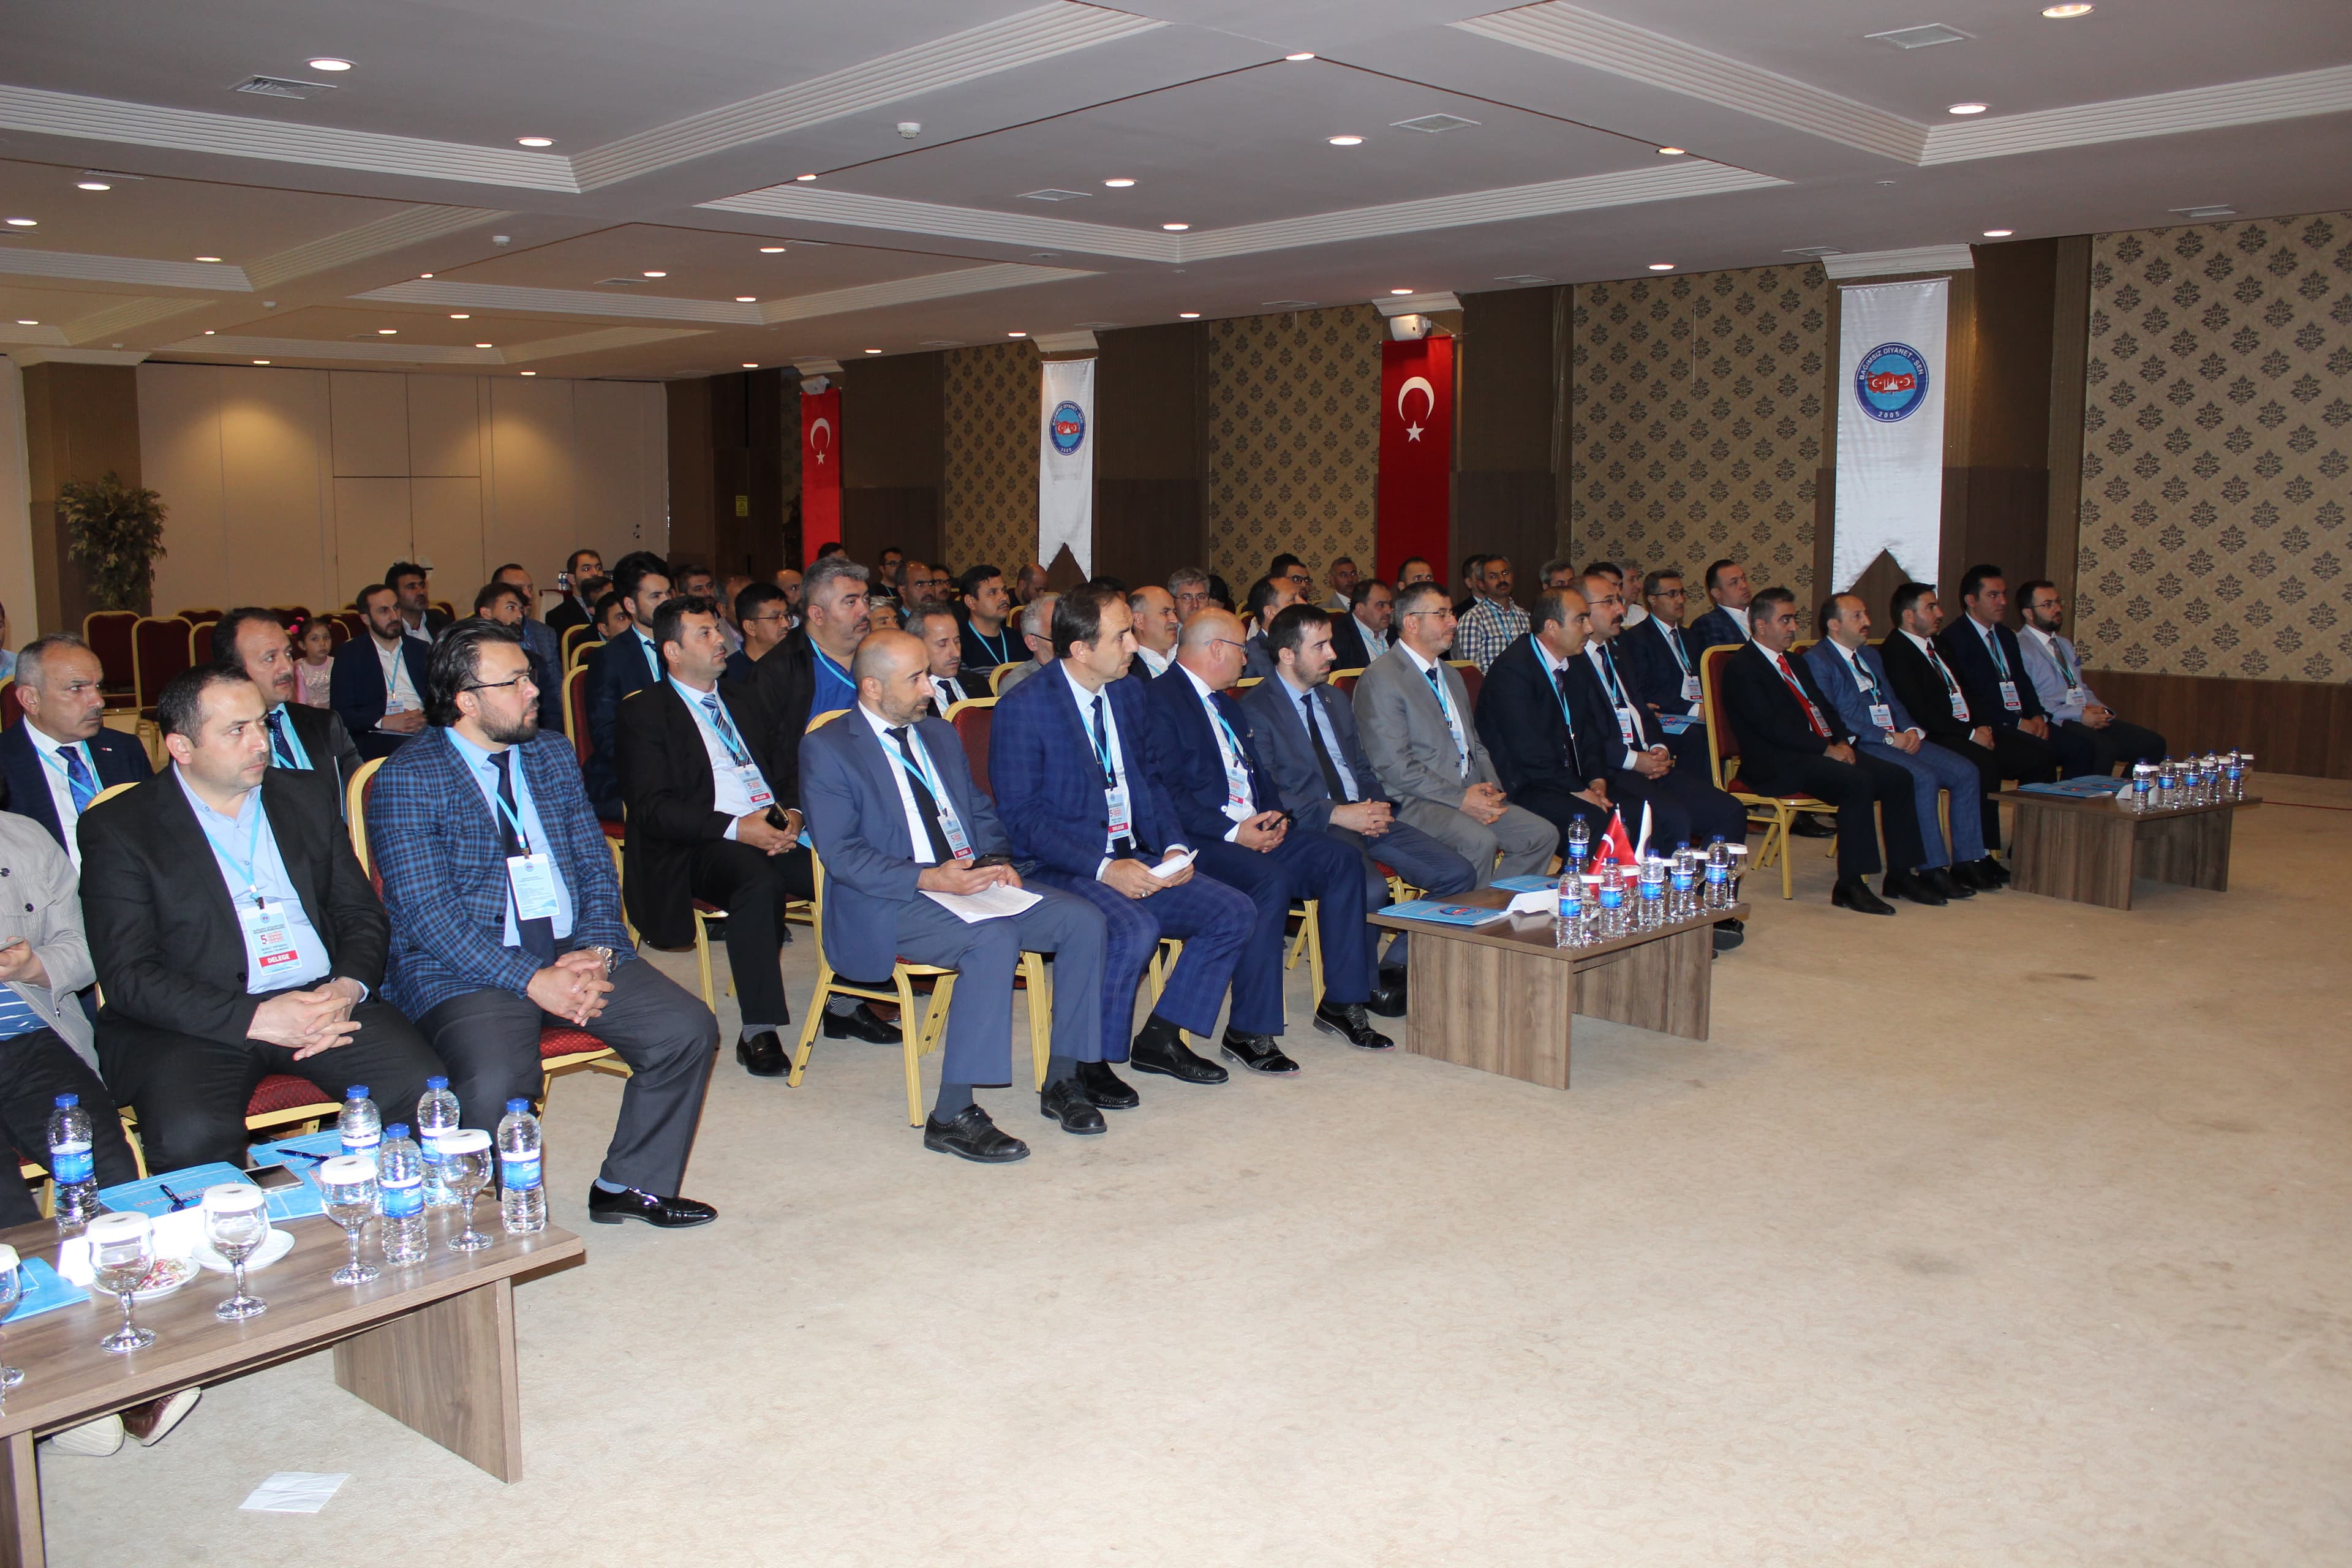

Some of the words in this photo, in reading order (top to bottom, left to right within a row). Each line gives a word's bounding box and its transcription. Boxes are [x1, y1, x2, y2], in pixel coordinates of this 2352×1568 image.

[1859, 350, 1882, 380] BAĞIMSIZ
[1883, 347, 1912, 358] DİYANET
[1913, 360, 1924, 375] SEN
[260, 934, 268, 944] 5
[267, 954, 290, 963] DELEGE
